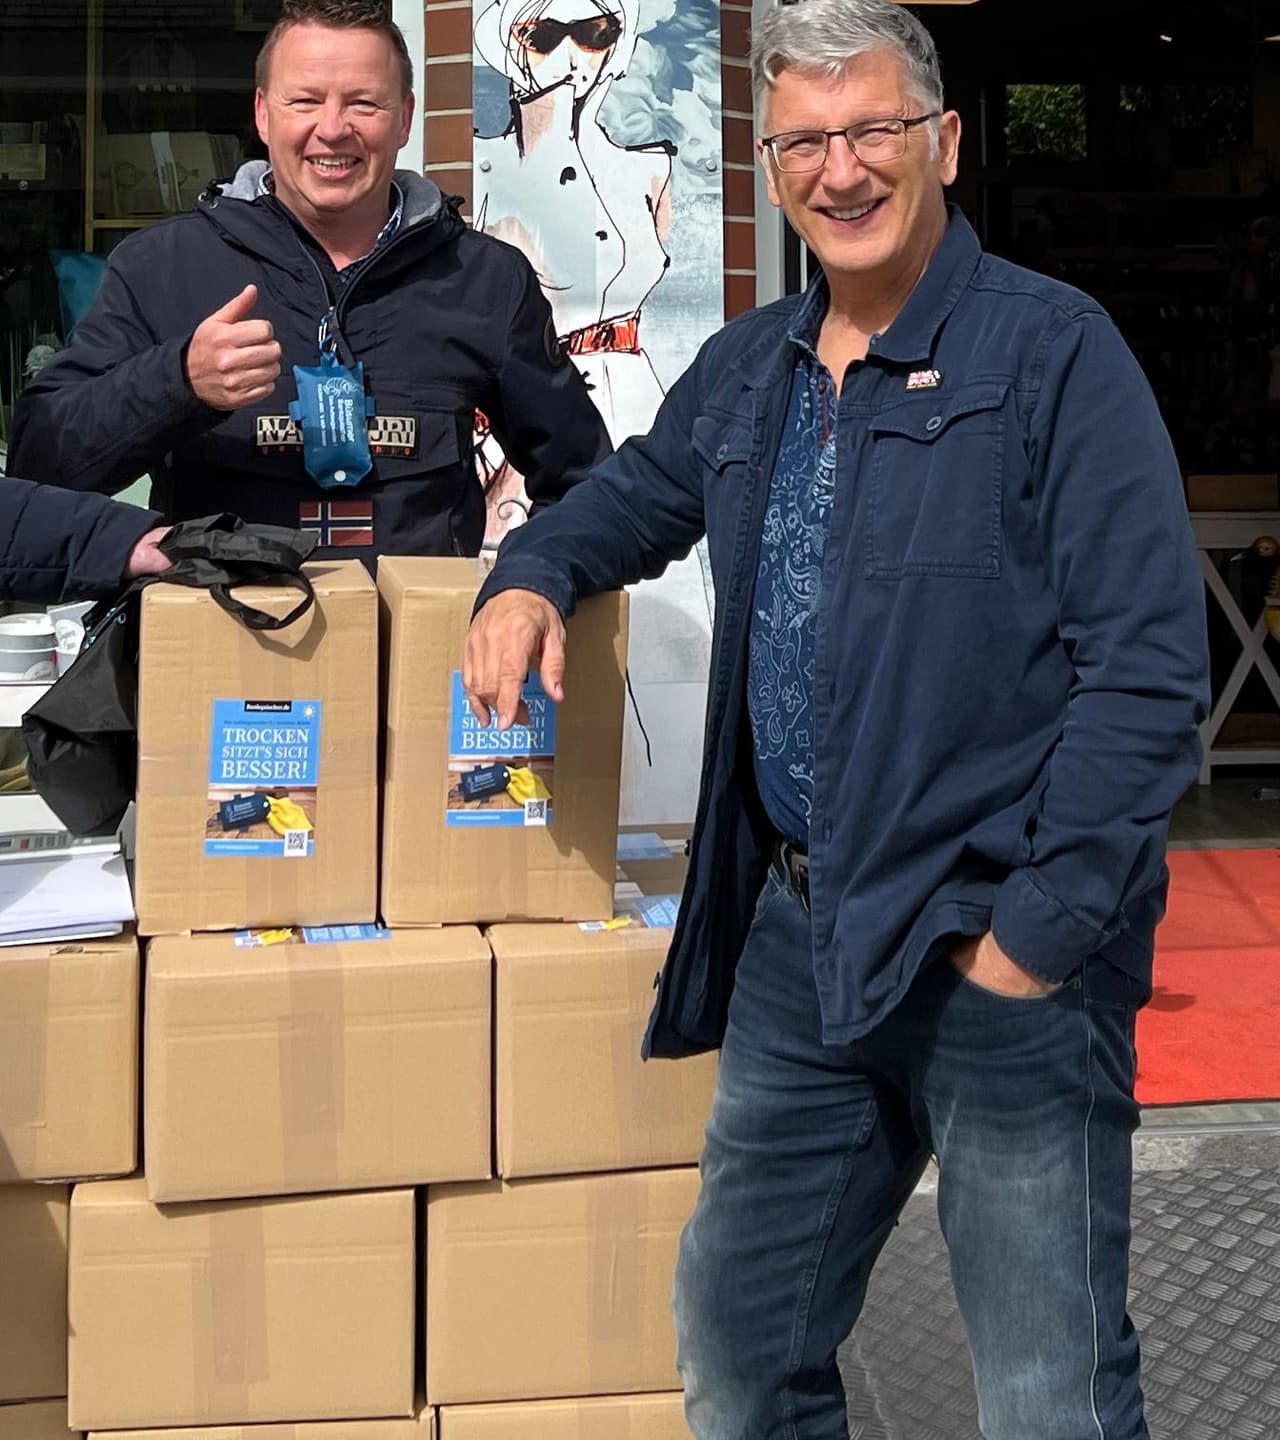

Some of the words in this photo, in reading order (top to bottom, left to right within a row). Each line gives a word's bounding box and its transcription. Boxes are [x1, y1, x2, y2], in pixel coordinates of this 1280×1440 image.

[222, 727, 310, 744] TROCKEN
[461, 730, 545, 750] BESSER!
[275, 746, 309, 759] SICH
[221, 760, 308, 779] BESSER!
